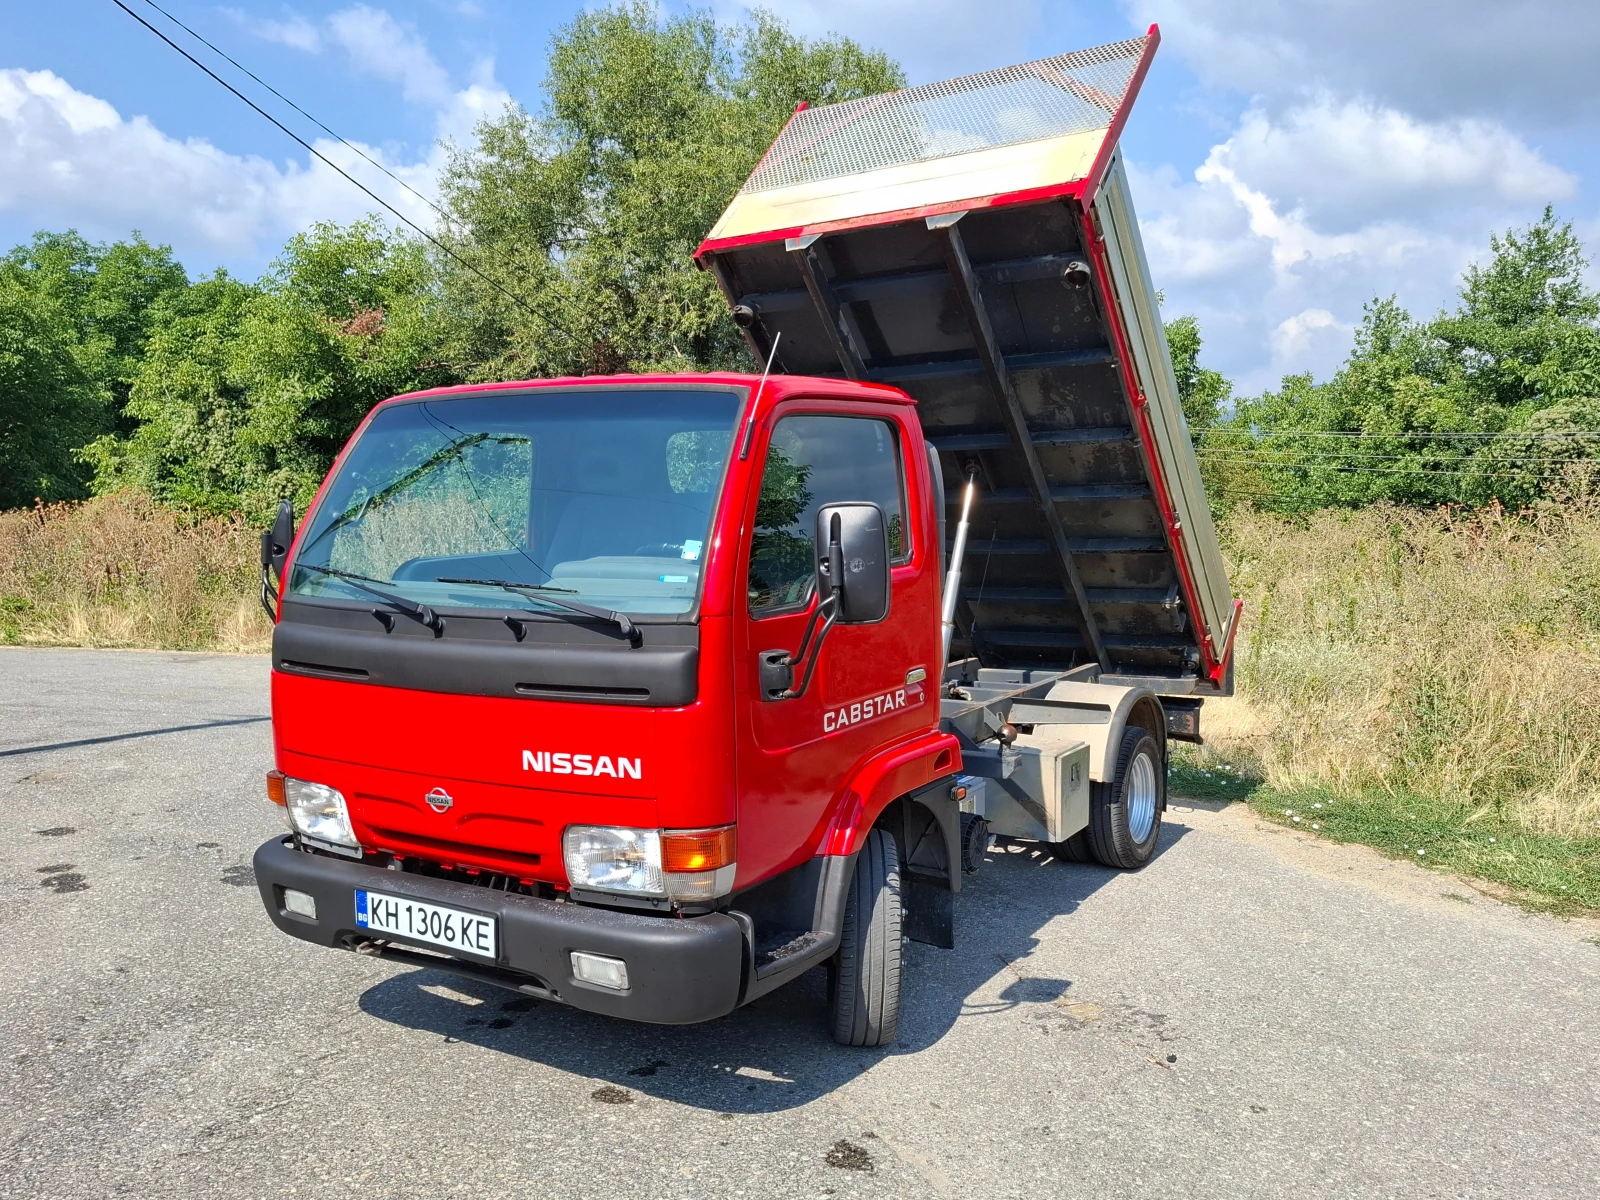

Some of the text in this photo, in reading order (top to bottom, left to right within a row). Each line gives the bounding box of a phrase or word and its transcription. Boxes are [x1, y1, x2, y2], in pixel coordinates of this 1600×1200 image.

[823, 689, 906, 733] CABSTAR
[522, 749, 642, 780] NISSAN
[427, 796, 450, 805] NISSAN
[357, 912, 368, 922] BG
